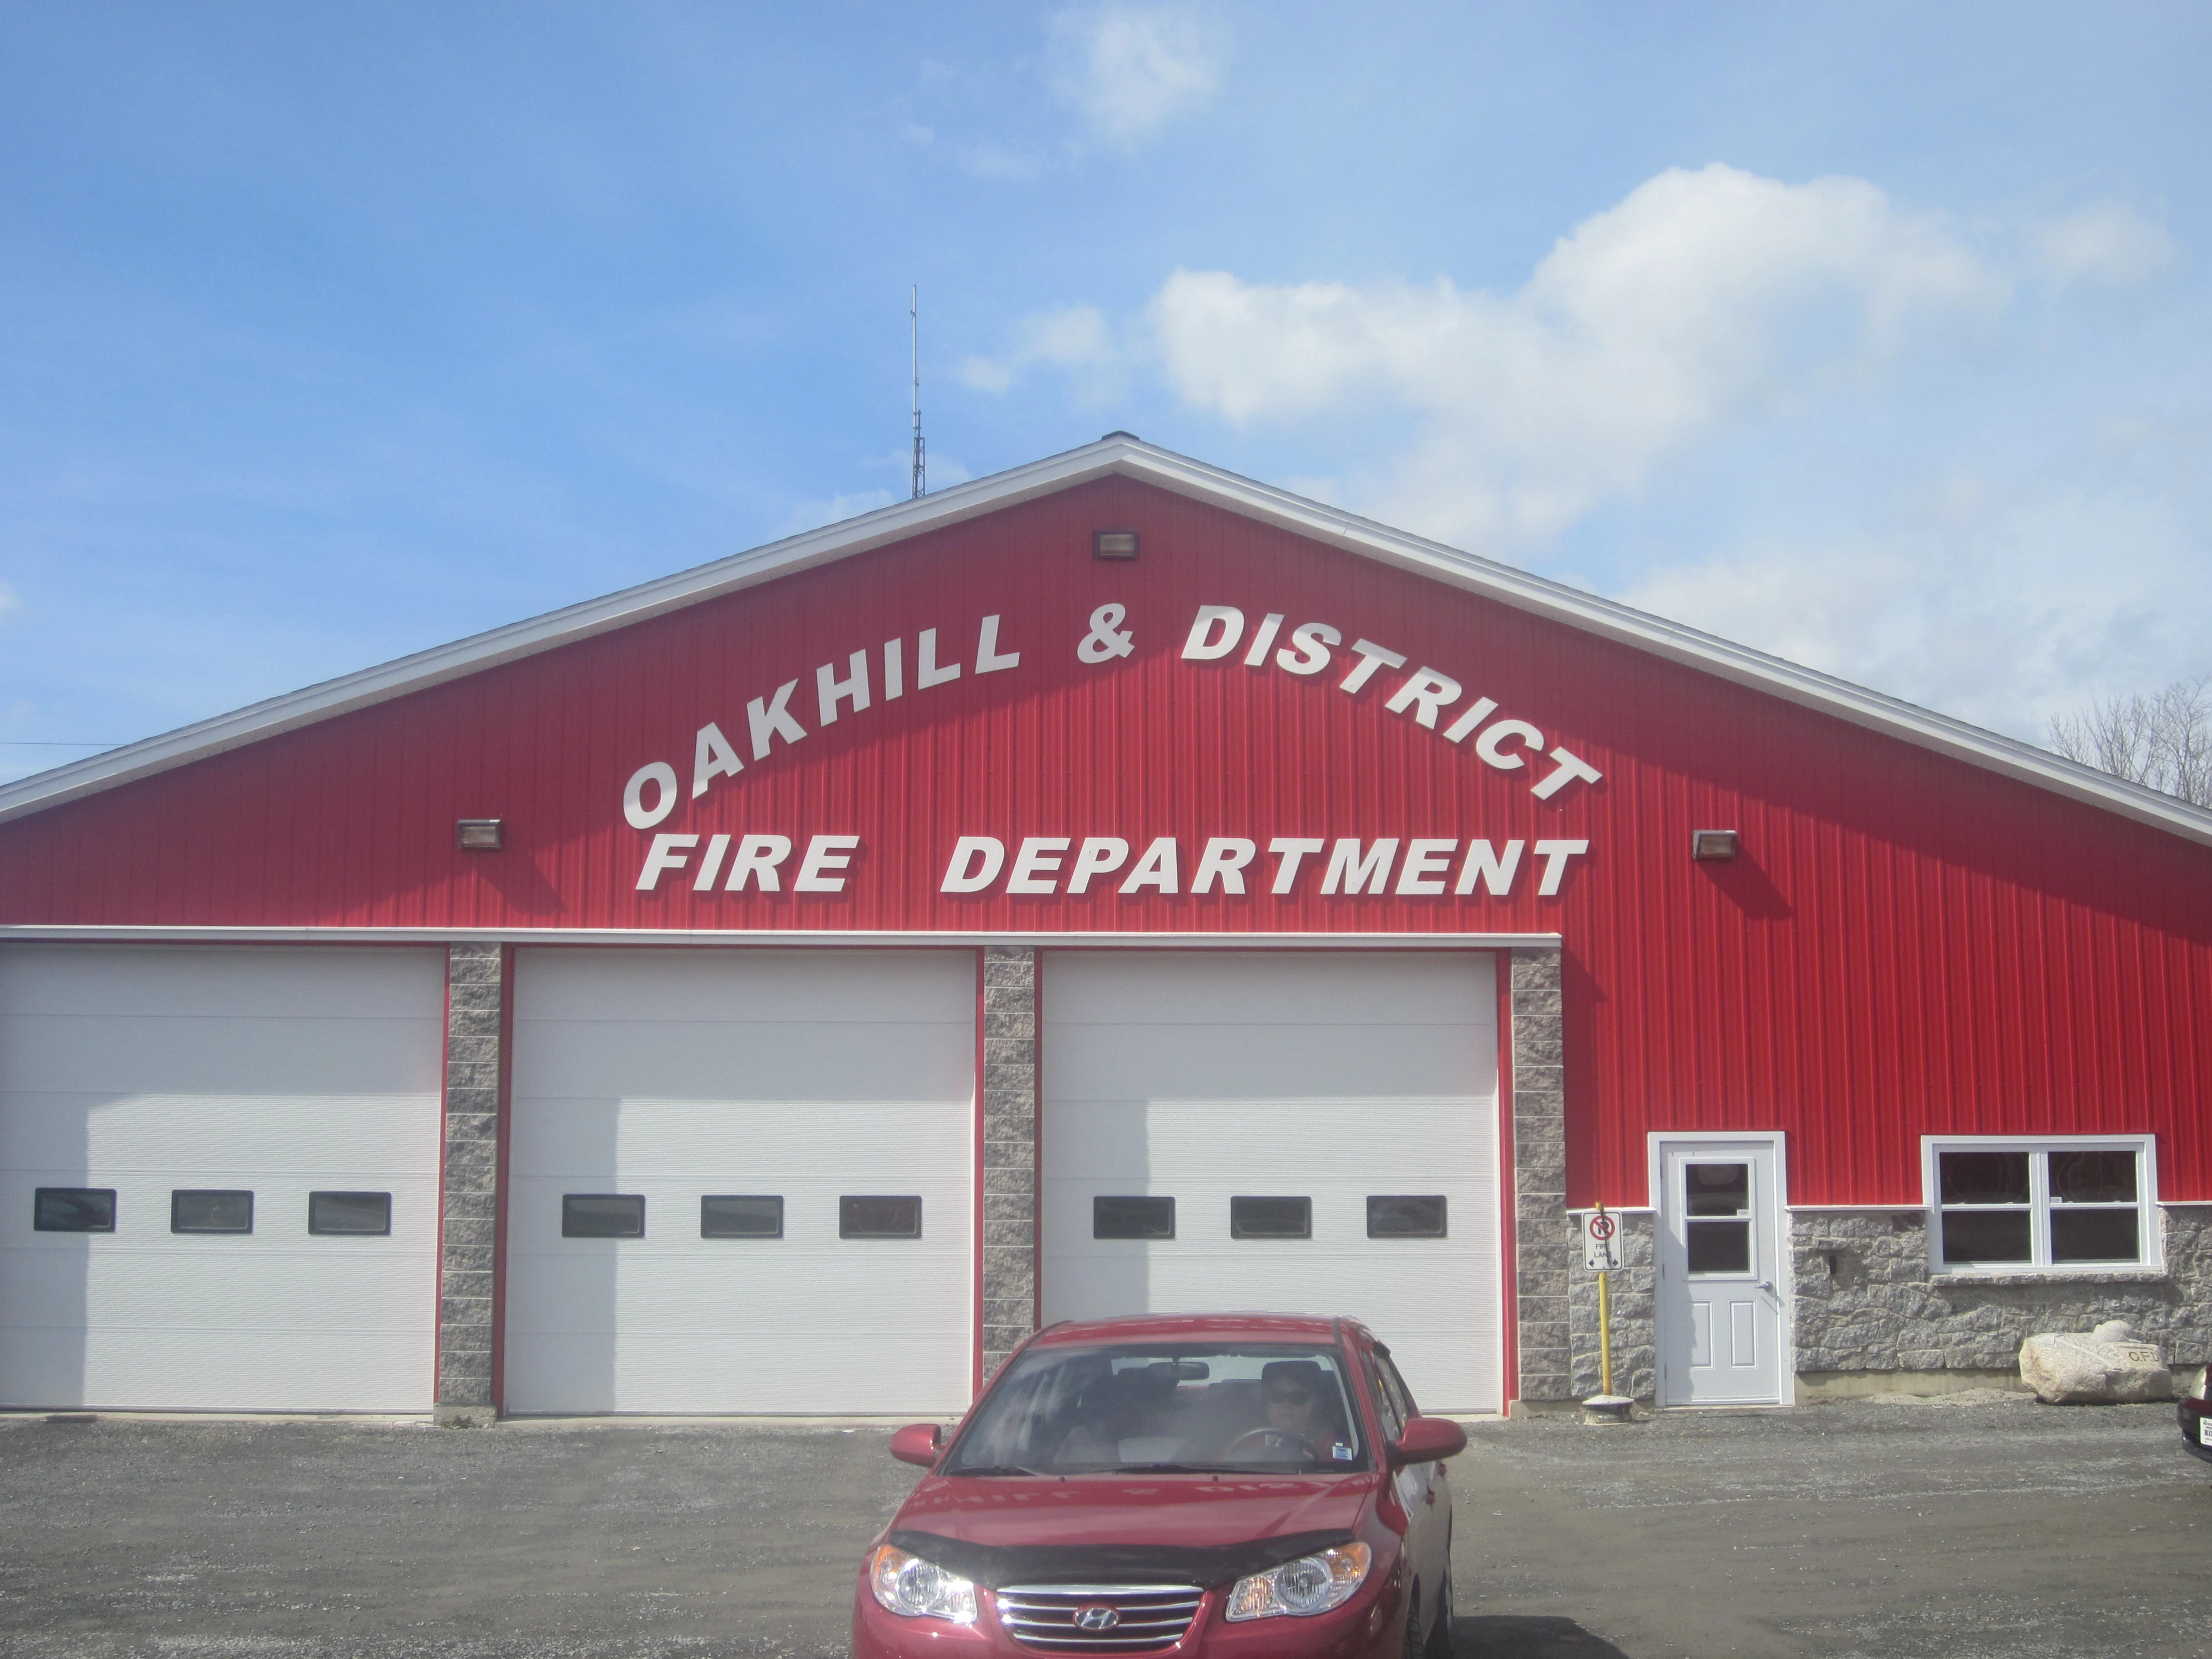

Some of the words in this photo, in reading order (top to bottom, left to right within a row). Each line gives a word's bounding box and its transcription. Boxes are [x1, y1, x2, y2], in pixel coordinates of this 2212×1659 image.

[623, 614, 1020, 830] OAKHILL
[1077, 603, 1135, 664] &
[1180, 604, 1603, 800] DISTRICT
[635, 833, 860, 892] FIRE
[940, 836, 1589, 896] DEPARTMENT
